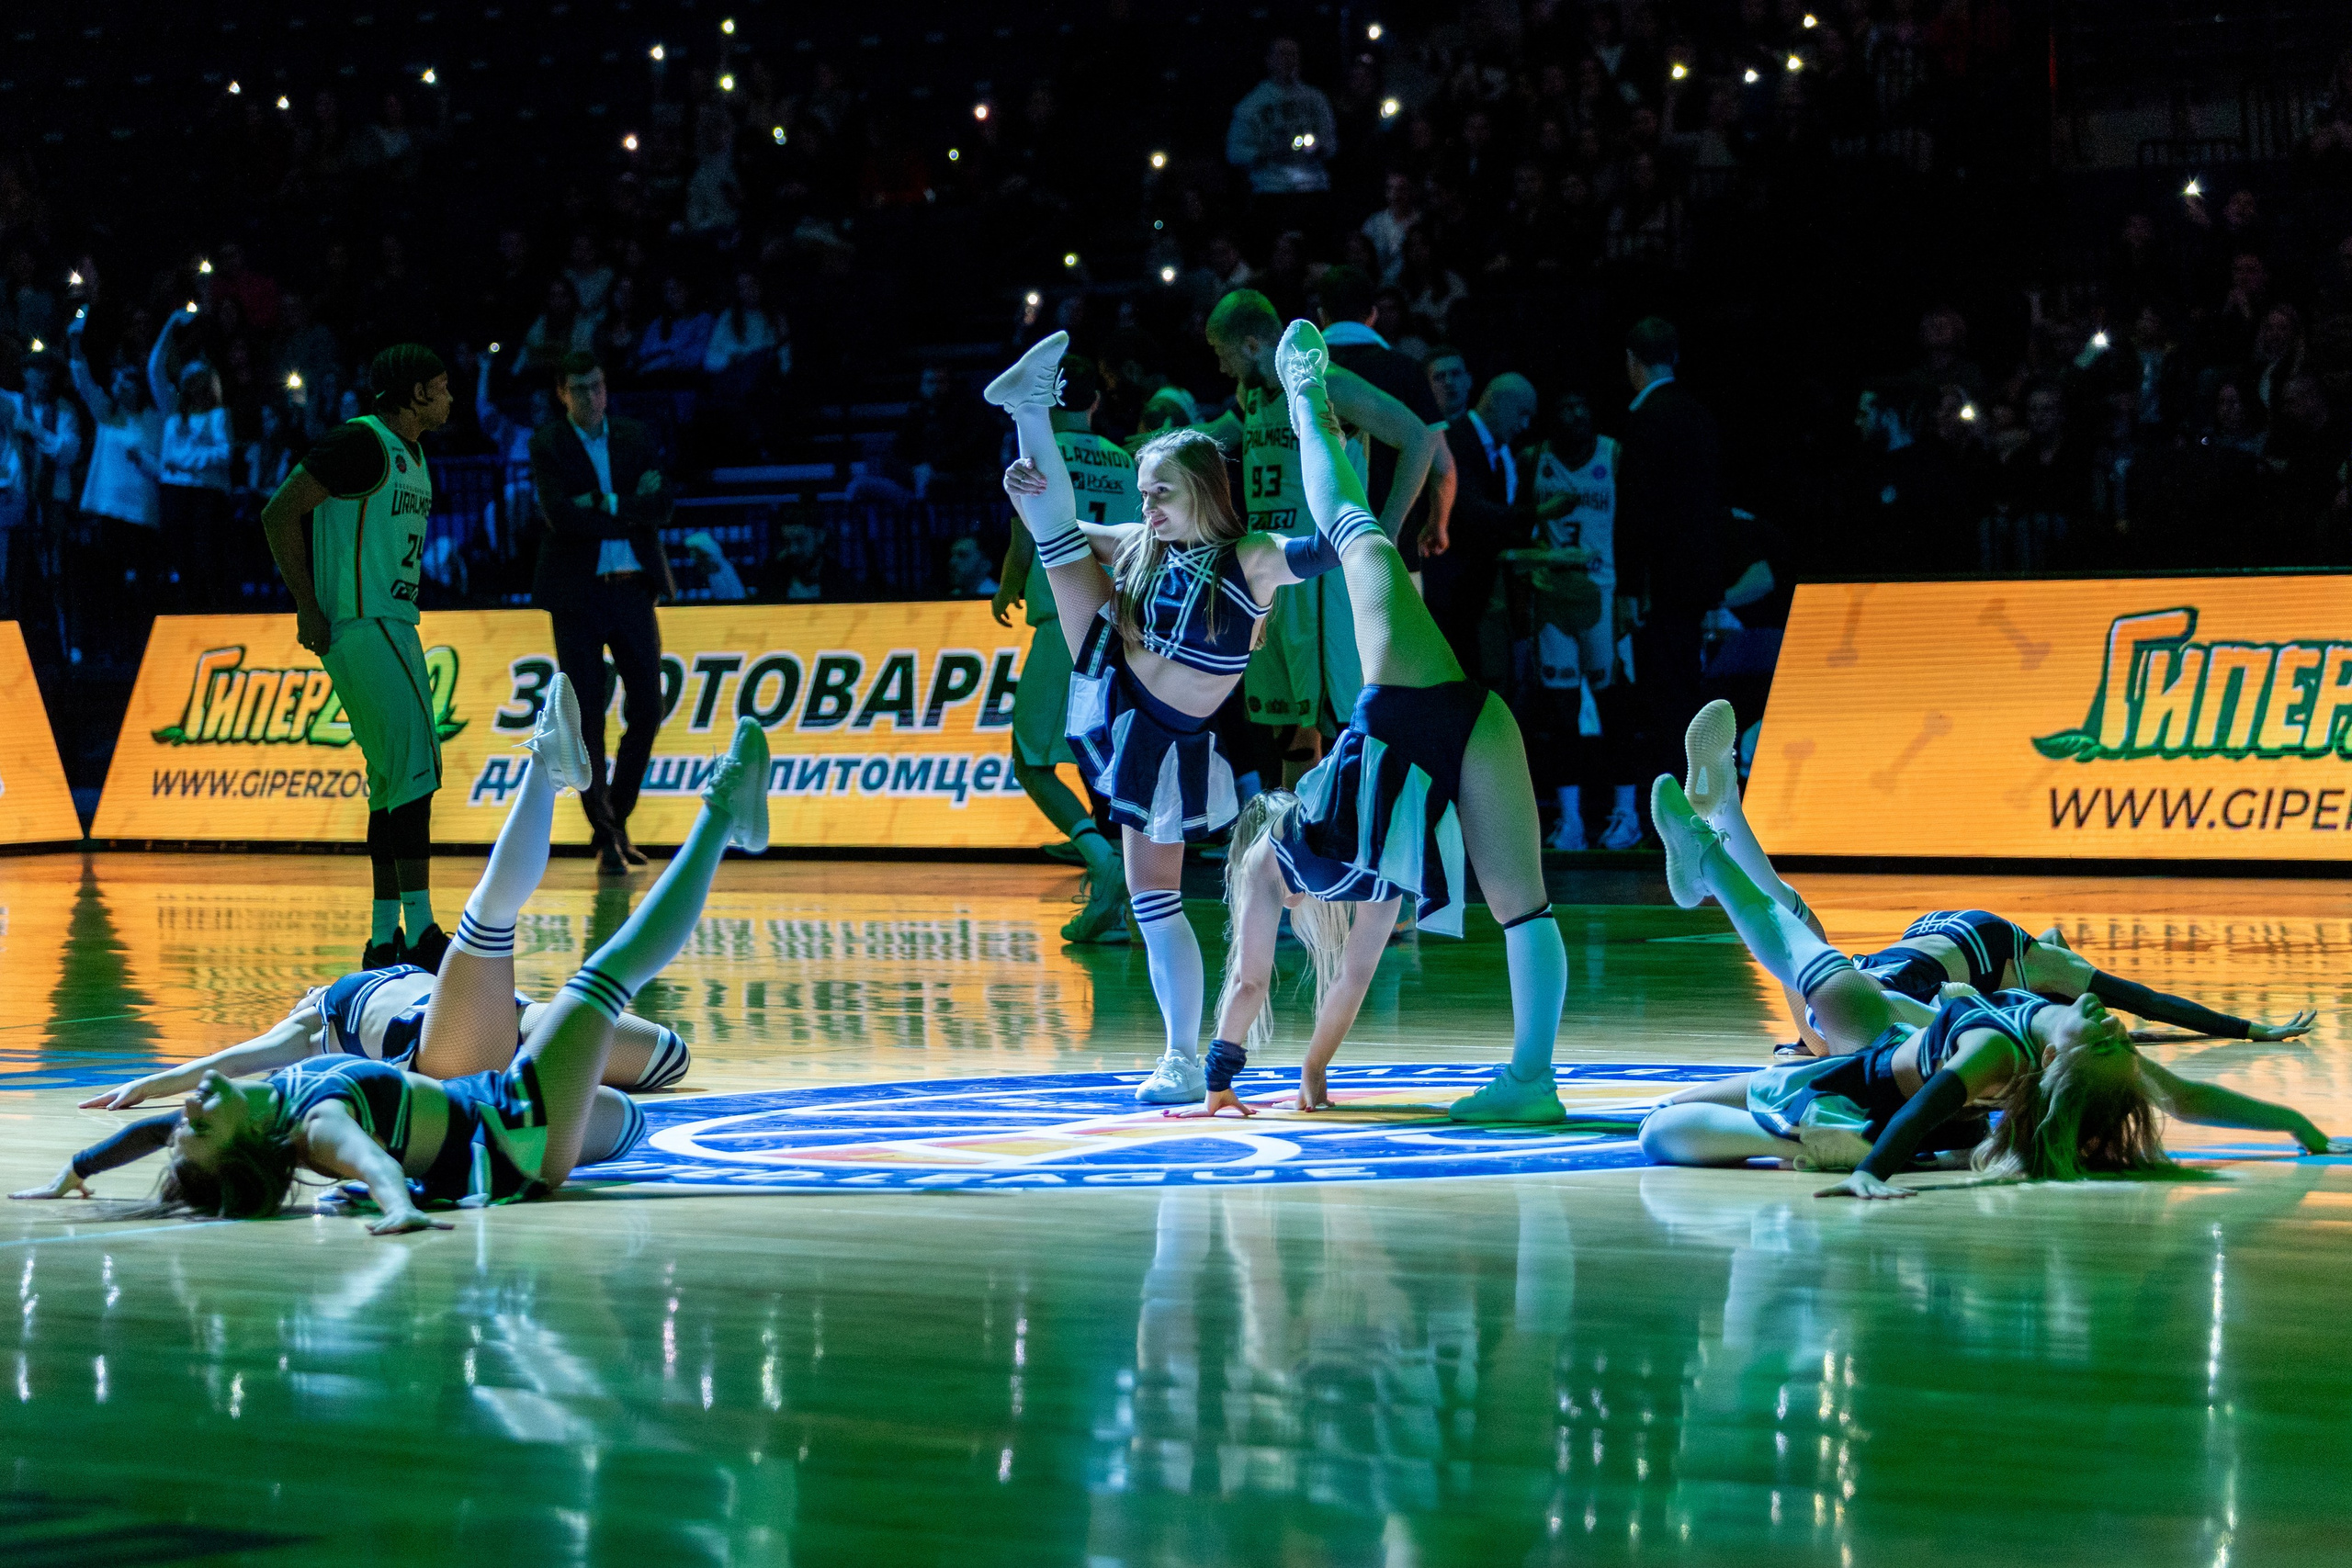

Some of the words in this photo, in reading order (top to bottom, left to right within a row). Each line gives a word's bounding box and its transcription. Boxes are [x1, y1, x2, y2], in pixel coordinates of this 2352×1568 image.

[1059, 446, 1130, 469] LAZUNOV
[1252, 464, 1282, 498] 93
[493, 650, 1020, 731] ЗТОВАР
[2084, 606, 2352, 759] ГИПЕР
[472, 755, 530, 801] дл
[2049, 787, 2352, 830] WWW.GIPE
[834, 1167, 1378, 1185] LEAGUE
